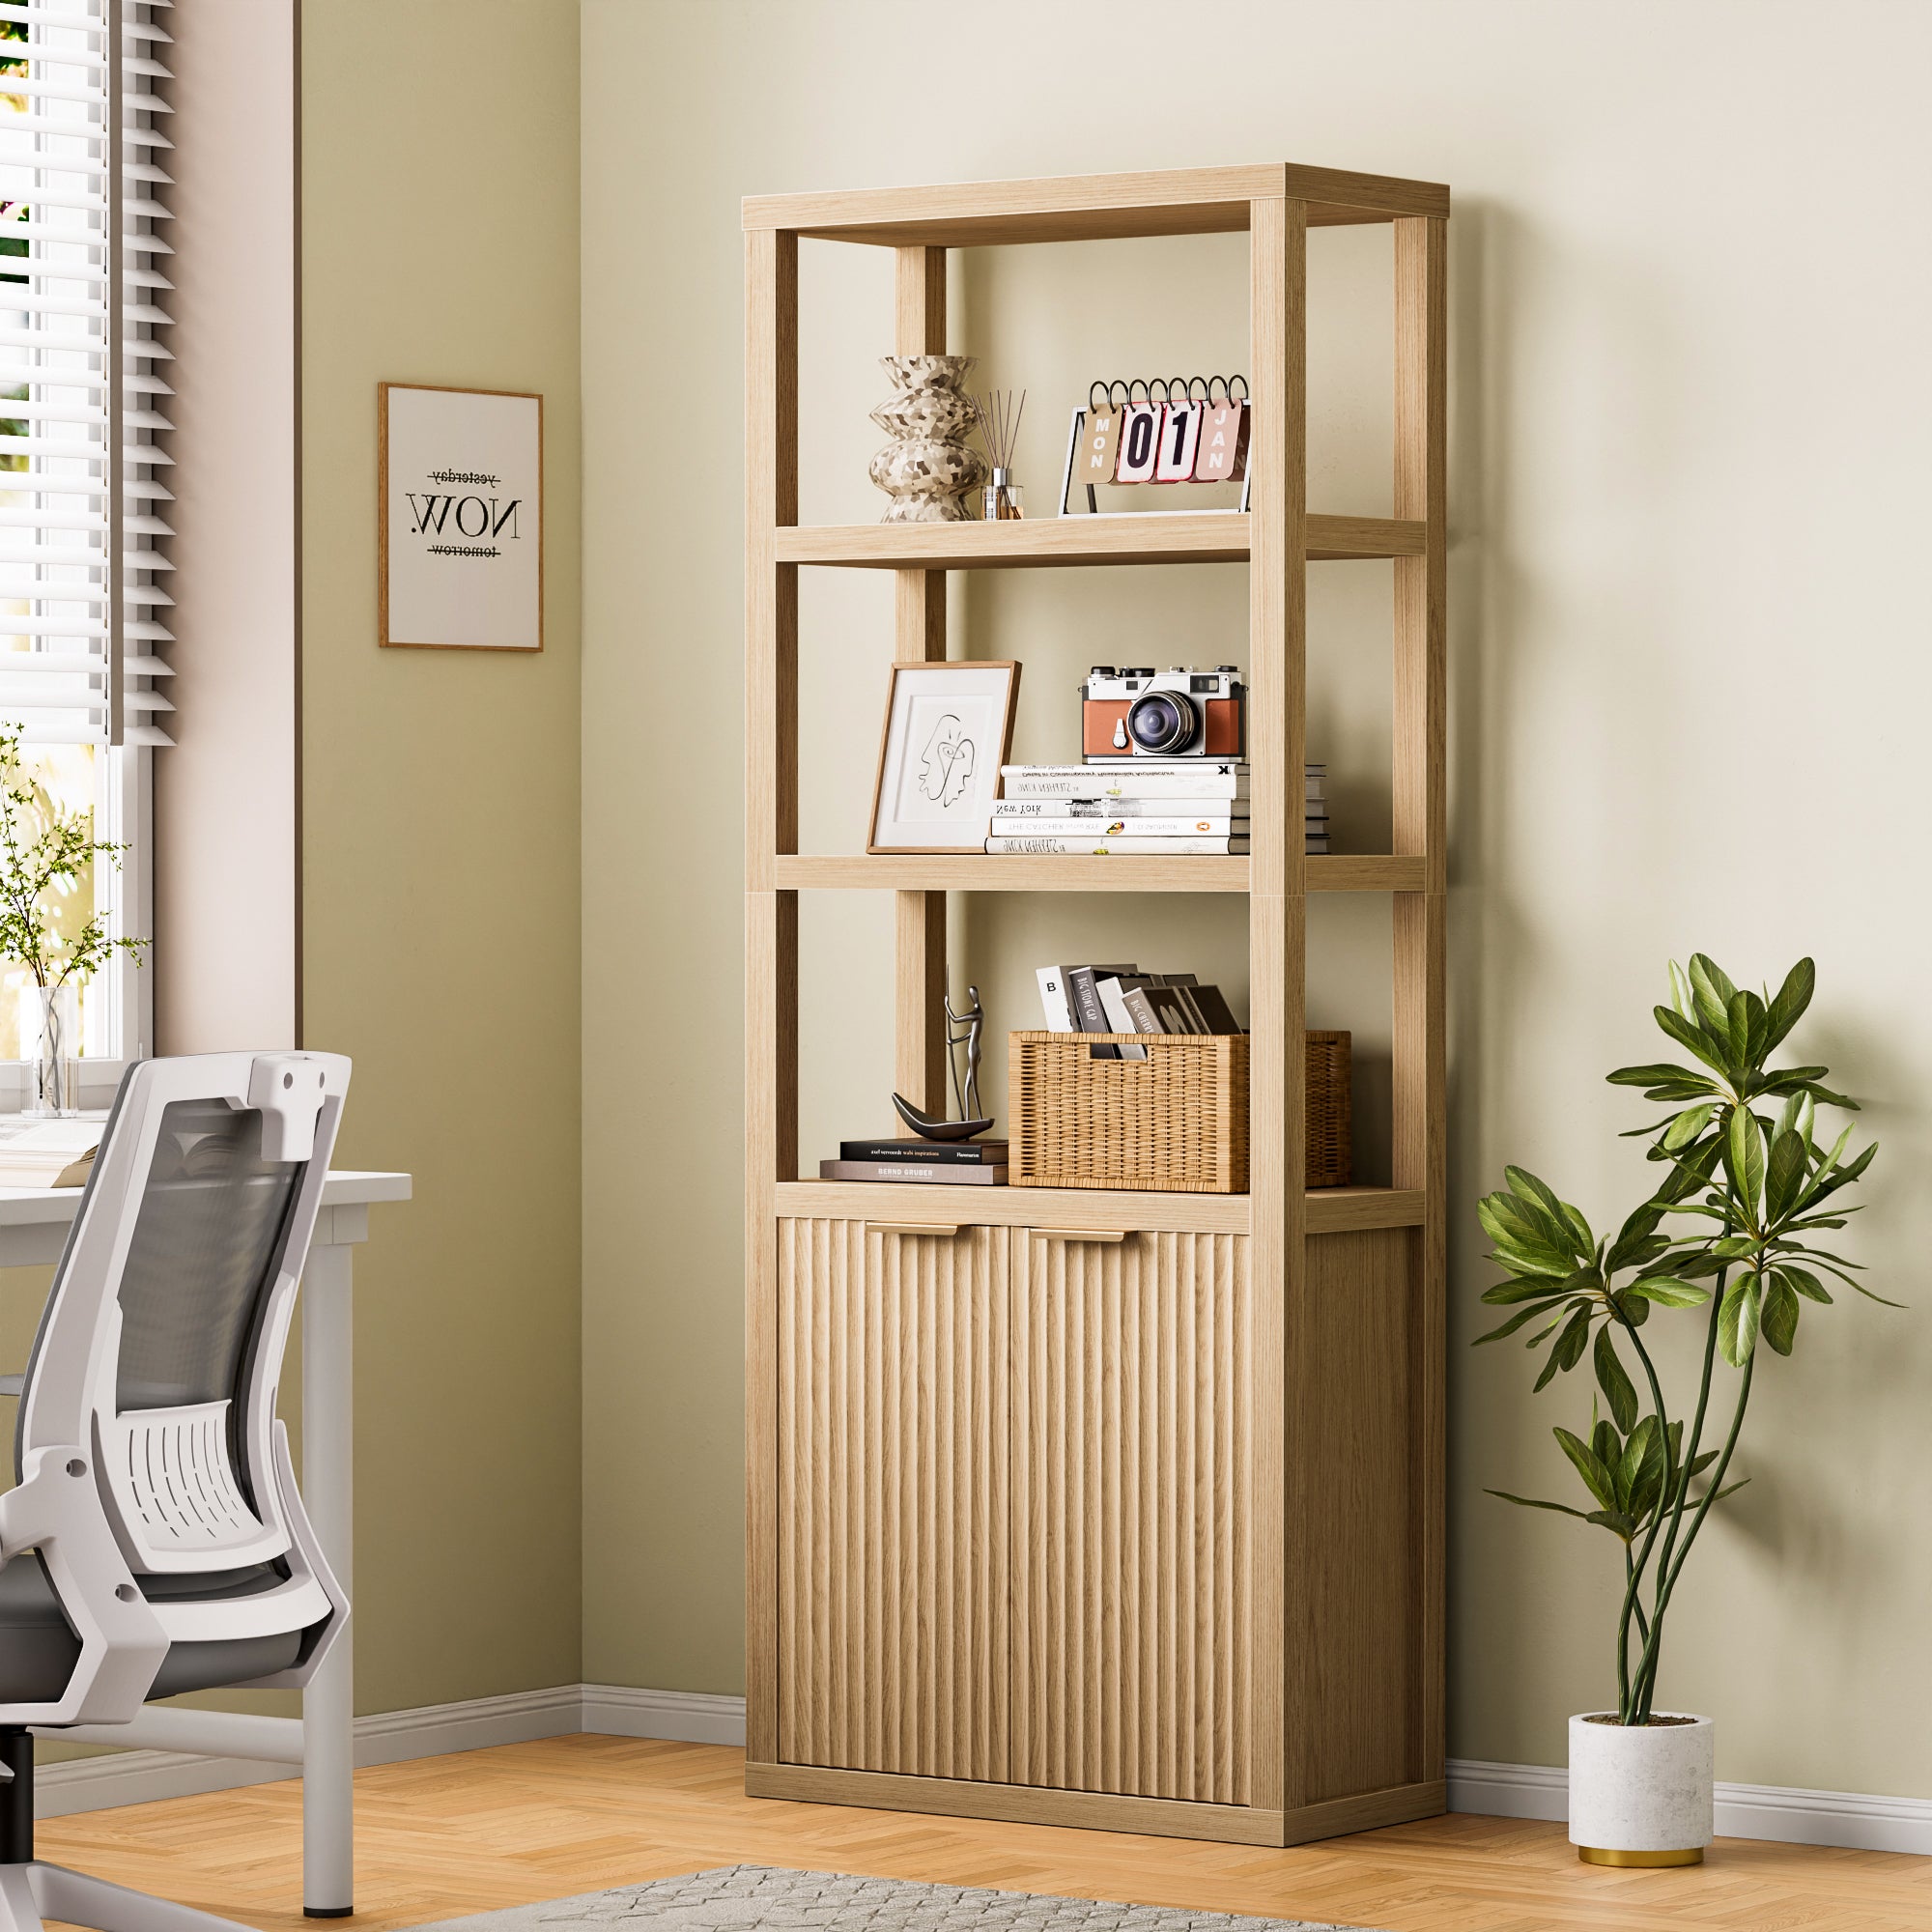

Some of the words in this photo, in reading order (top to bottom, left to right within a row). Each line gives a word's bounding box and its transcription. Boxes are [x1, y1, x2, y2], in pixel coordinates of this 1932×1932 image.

[1090, 418, 1110, 469] MON
[1126, 412, 1188, 469] 01
[1208, 410, 1228, 469] JAN
[1046, 981, 1057, 992] B
[1077, 977, 1090, 990] BIG
[1080, 989, 1094, 1008] STONE
[1130, 999, 1142, 1012] BIG
[1086, 1009, 1097, 1021] GAP
[877, 1167, 902, 1176] BERND
[903, 1168, 934, 1177] GRUBER
